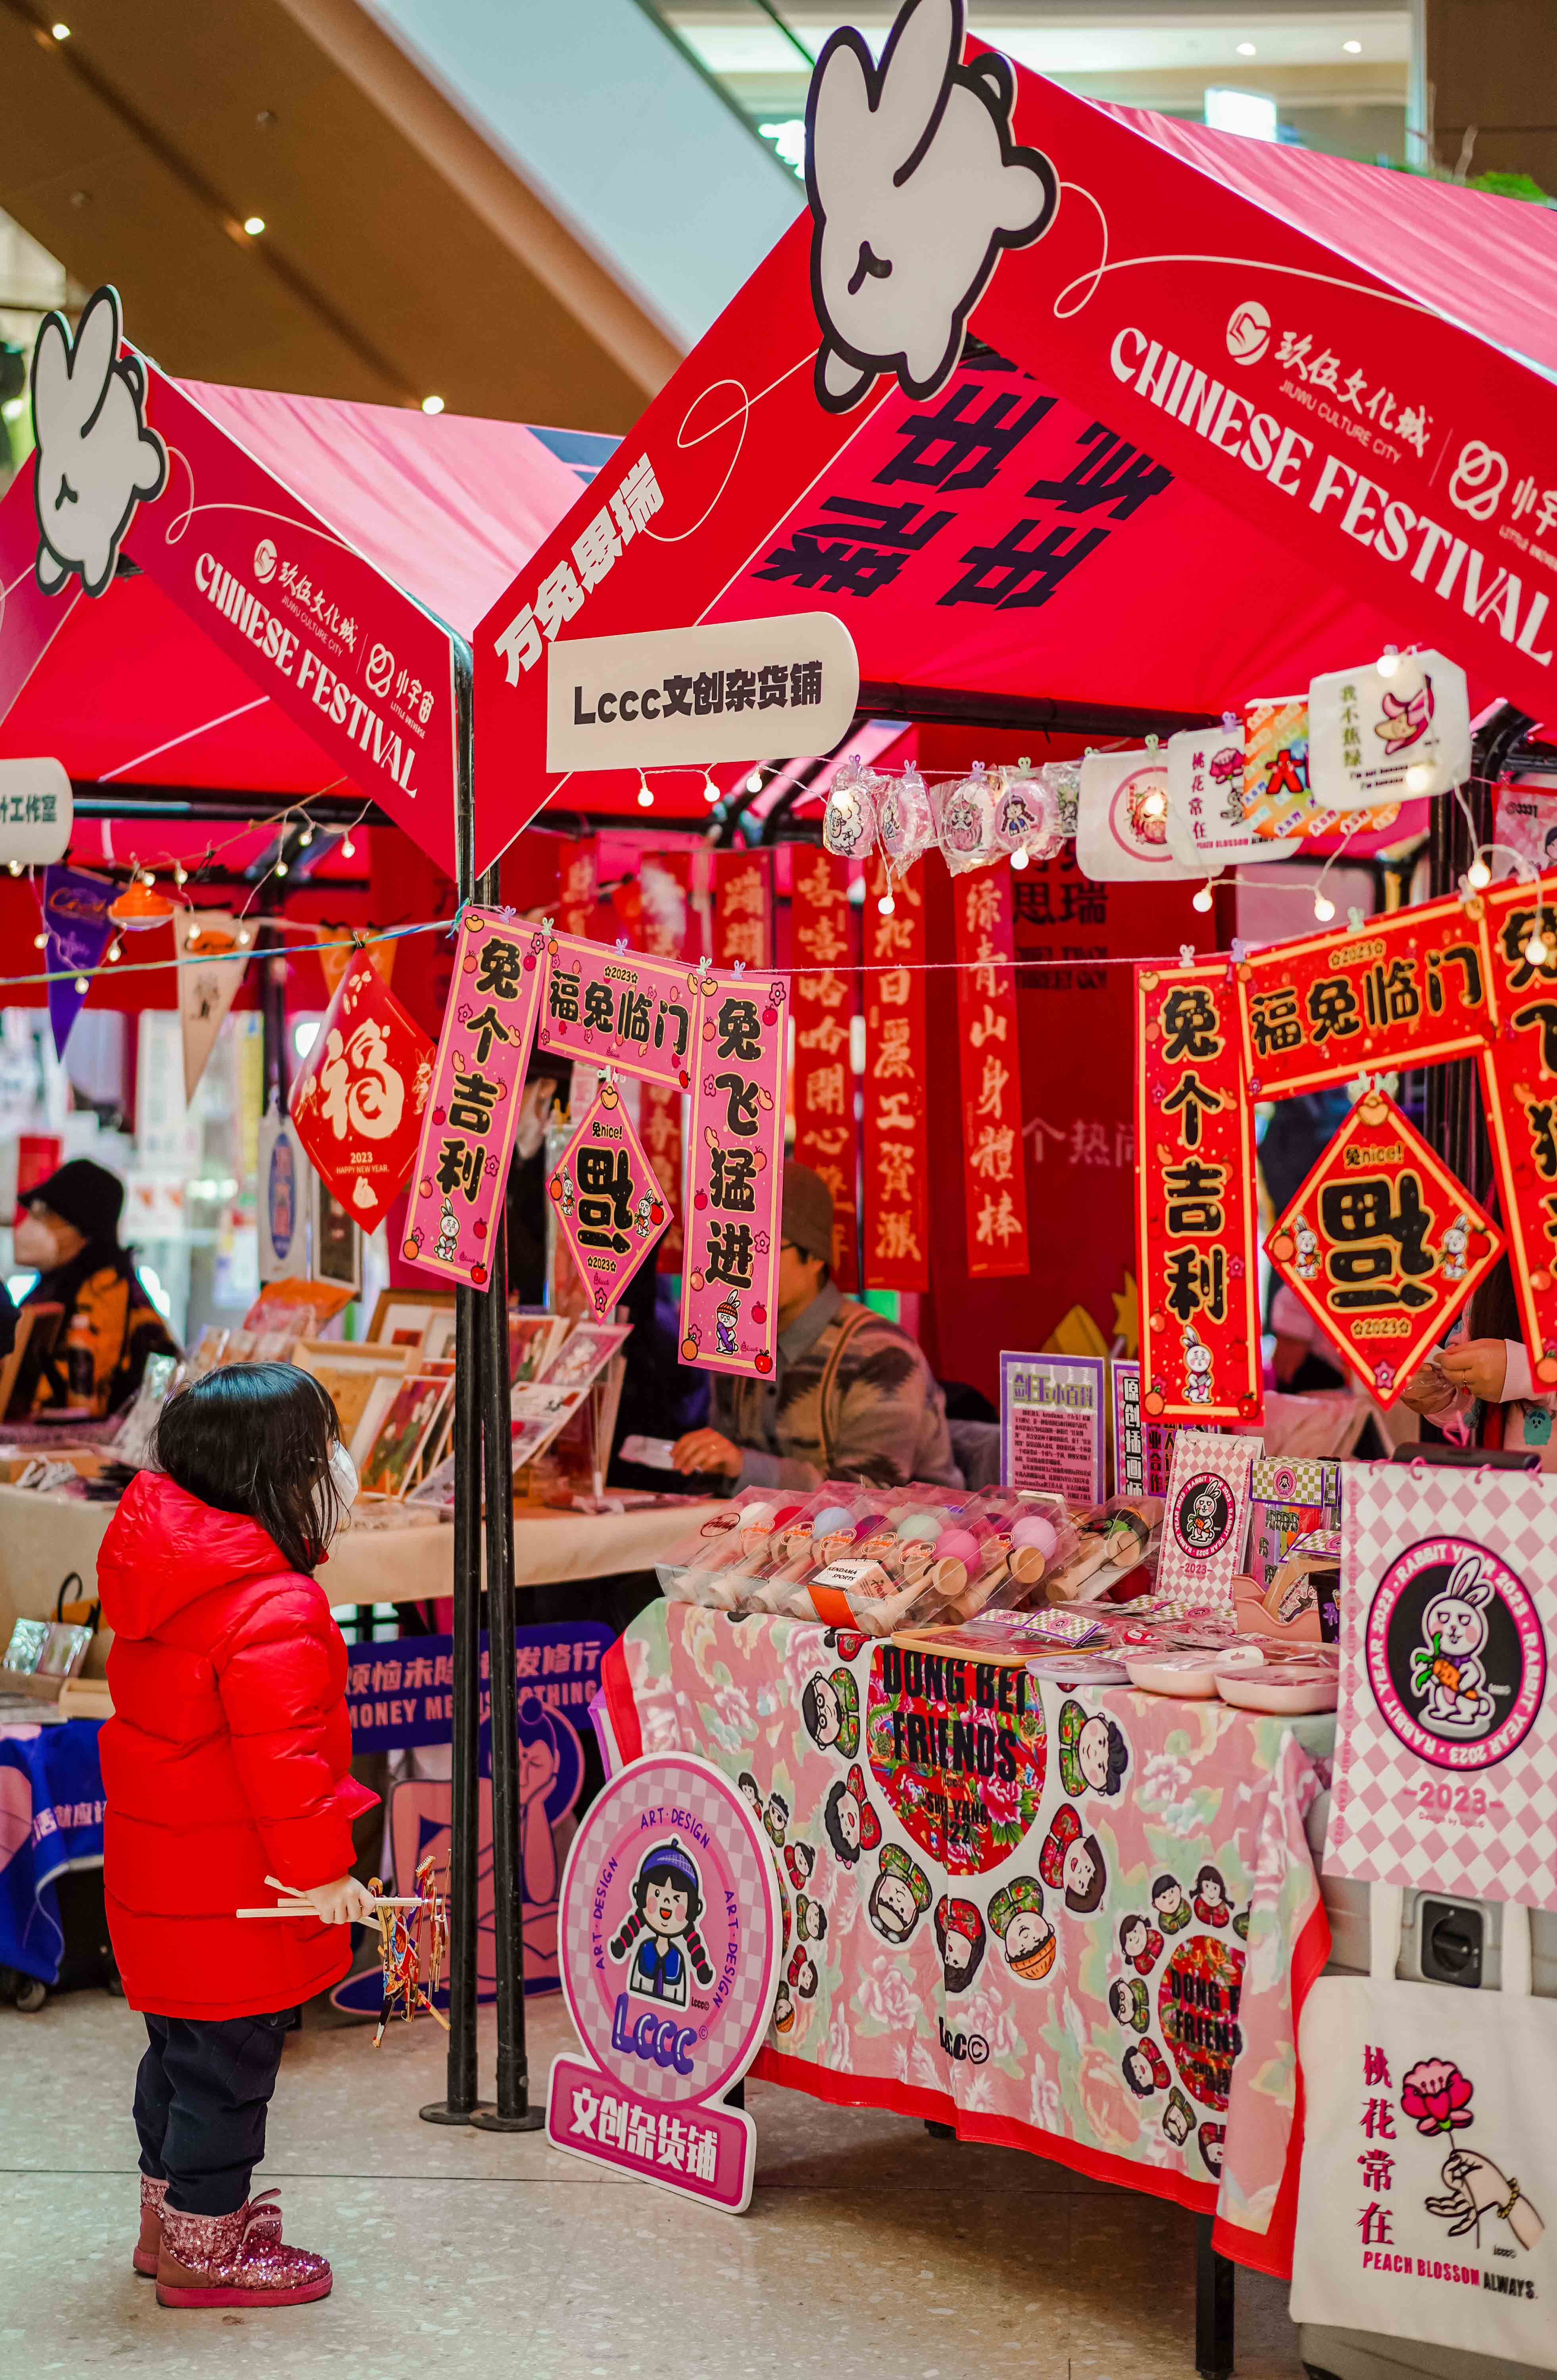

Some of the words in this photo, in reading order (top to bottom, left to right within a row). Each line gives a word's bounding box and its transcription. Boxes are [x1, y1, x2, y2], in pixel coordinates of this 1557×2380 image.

[1274, 331, 1433, 458] 玖伍文化城
[1279, 380, 1317, 411] JIUWU
[1318, 403, 1372, 447] CULTURE
[1372, 438, 1402, 464] CITY
[1110, 327, 1314, 497] CHINESE
[1309, 454, 1554, 666] FESTIVAL
[278, 561, 358, 654] 玖伍文化城
[281, 595, 300, 617] JIUWU
[300, 612, 329, 645] CULTURE
[328, 639, 343, 657] CITY
[194, 553, 299, 676] CHINESE
[296, 648, 418, 798] FESTIVAL
[396, 668, 434, 724] 小宇宙
[390, 701, 404, 720] LITTLE
[405, 716, 426, 739] UNIVERSE
[1013, 881, 1108, 925] 思瑞
[611, 969, 632, 981] 2023
[321, 1018, 405, 1140] 福
[350, 1152, 373, 1163] 2023
[577, 1146, 634, 1254] 福
[593, 1256, 610, 1271] 2023
[1322, 1173, 1434, 1309] 福
[1148, 1423, 1161, 1493] 业合作
[1174, 1492, 1185, 1511] 2023
[1187, 1475, 1207, 1490] RABBIT
[1222, 1487, 1231, 1502] 2023
[827, 1566, 857, 1575] KENDAMA
[1177, 1533, 1192, 1554] RABBIT
[1211, 1534, 1227, 1553] YEAR
[1396, 1543, 1449, 1582] RABBIT
[1495, 1574, 1529, 1617] 2023
[1372, 1590, 1395, 1635] 2023
[518, 1681, 596, 1706] OTHING
[883, 1645, 965, 1704] DONG
[976, 1663, 1028, 1715] BEI
[1368, 1639, 1388, 1696] YEAR
[1522, 1631, 1540, 1713] RABBIT
[893, 1710, 1017, 1783] FRIENDS
[1383, 1700, 1436, 1756] RABBIT
[1449, 1744, 1488, 1765] 2023
[1490, 1711, 1528, 1756] YEAR
[1171, 1968, 1221, 2011] DONG
[1176, 2009, 1230, 2053] FRIEN
[570, 2087, 717, 2182] 文创杂货铺
[1357, 2044, 1397, 2246] 桃花常在
[1363, 2251, 1413, 2274] PEACH
[1417, 2258, 1479, 2286] BLOSSOM
